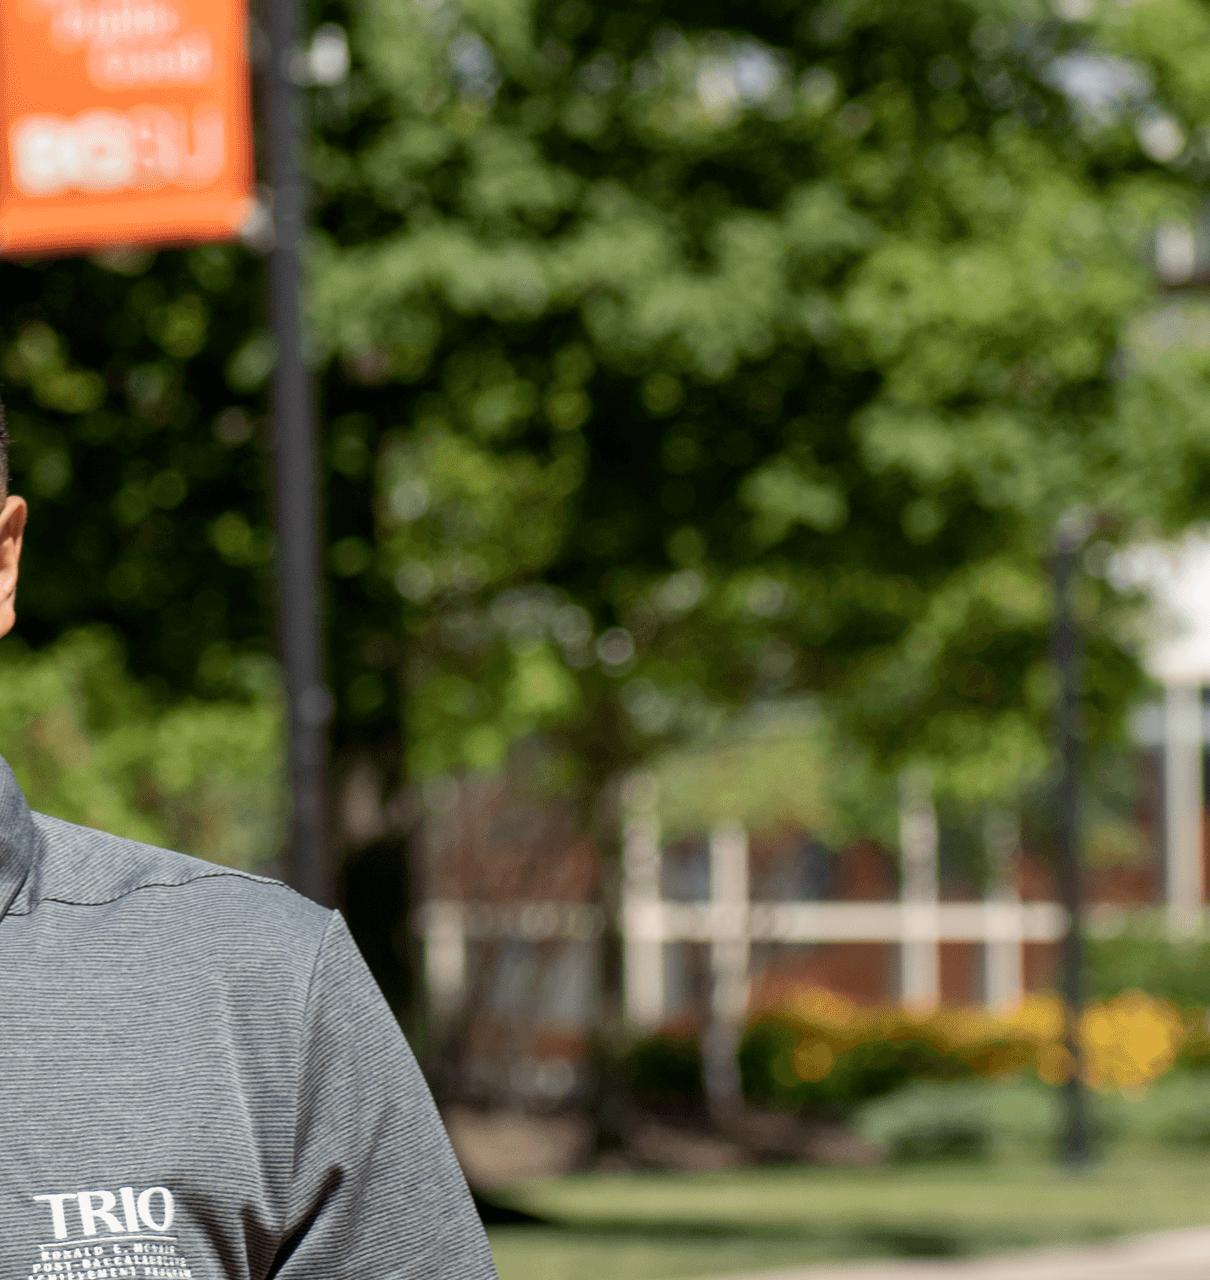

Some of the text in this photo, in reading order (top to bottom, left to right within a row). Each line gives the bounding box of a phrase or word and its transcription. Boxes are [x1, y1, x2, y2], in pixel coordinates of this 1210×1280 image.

[33, 1186, 176, 1239] TRIO
[40, 1246, 104, 1261] RONALD
[113, 1243, 129, 1254] E.
